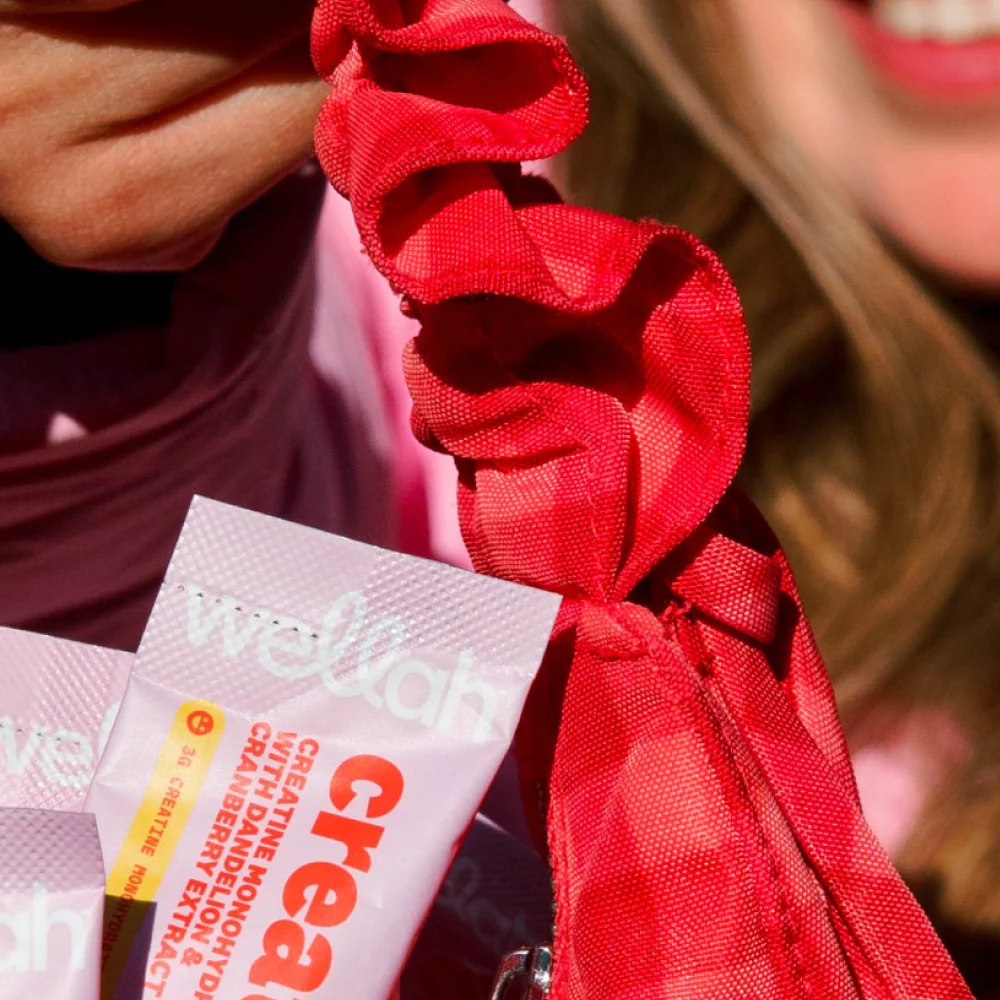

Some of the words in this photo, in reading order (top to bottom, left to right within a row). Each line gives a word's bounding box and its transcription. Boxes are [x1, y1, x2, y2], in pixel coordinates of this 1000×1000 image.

[186, 584, 498, 743] wellah
[176, 745, 197, 768] 3G
[196, 722, 272, 877] CRANBERRY
[253, 738, 319, 862] CREATINE
[254, 732, 298, 799] WITH
[140, 776, 184, 858] CREATINE
[189, 802, 268, 945] DANDELION
[144, 879, 208, 998] EXTRACT
[180, 947, 203, 967] &
